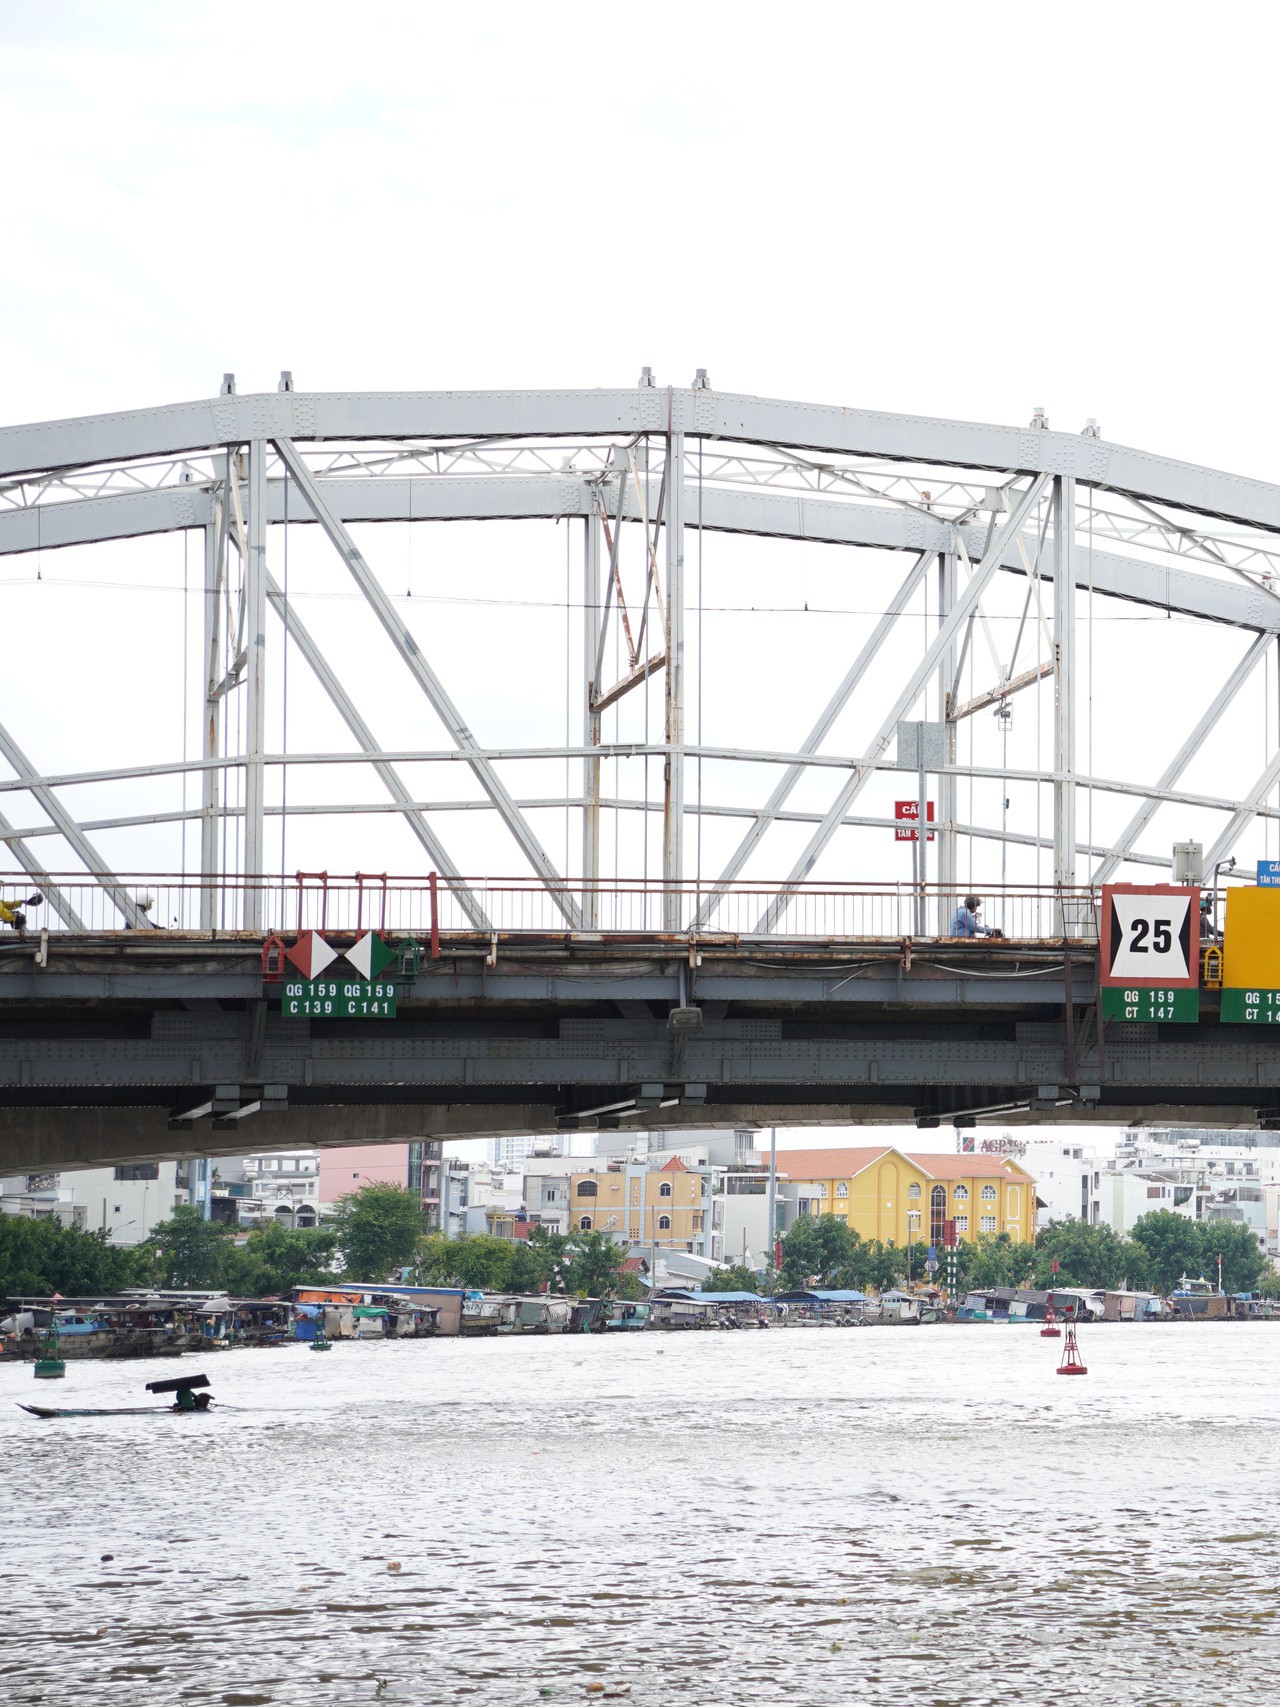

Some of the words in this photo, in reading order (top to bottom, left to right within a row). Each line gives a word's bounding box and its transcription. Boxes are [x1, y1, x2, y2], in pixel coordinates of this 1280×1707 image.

[1129, 918, 1172, 954] 25
[286, 984, 303, 997] QG
[308, 984, 337, 997] 159
[344, 984, 361, 998] QG
[365, 985, 394, 998] 159
[1124, 990, 1139, 1003] QG
[1149, 990, 1175, 1003] 159
[1245, 992, 1260, 1005] QG
[290, 1001, 298, 1014] C
[304, 1001, 332, 1014] 139
[348, 1001, 356, 1014] C
[361, 1001, 388, 1015] 141
[1125, 1007, 1139, 1018] CT
[1149, 1007, 1175, 1019] 147
[1245, 1008, 1259, 1020] CT
